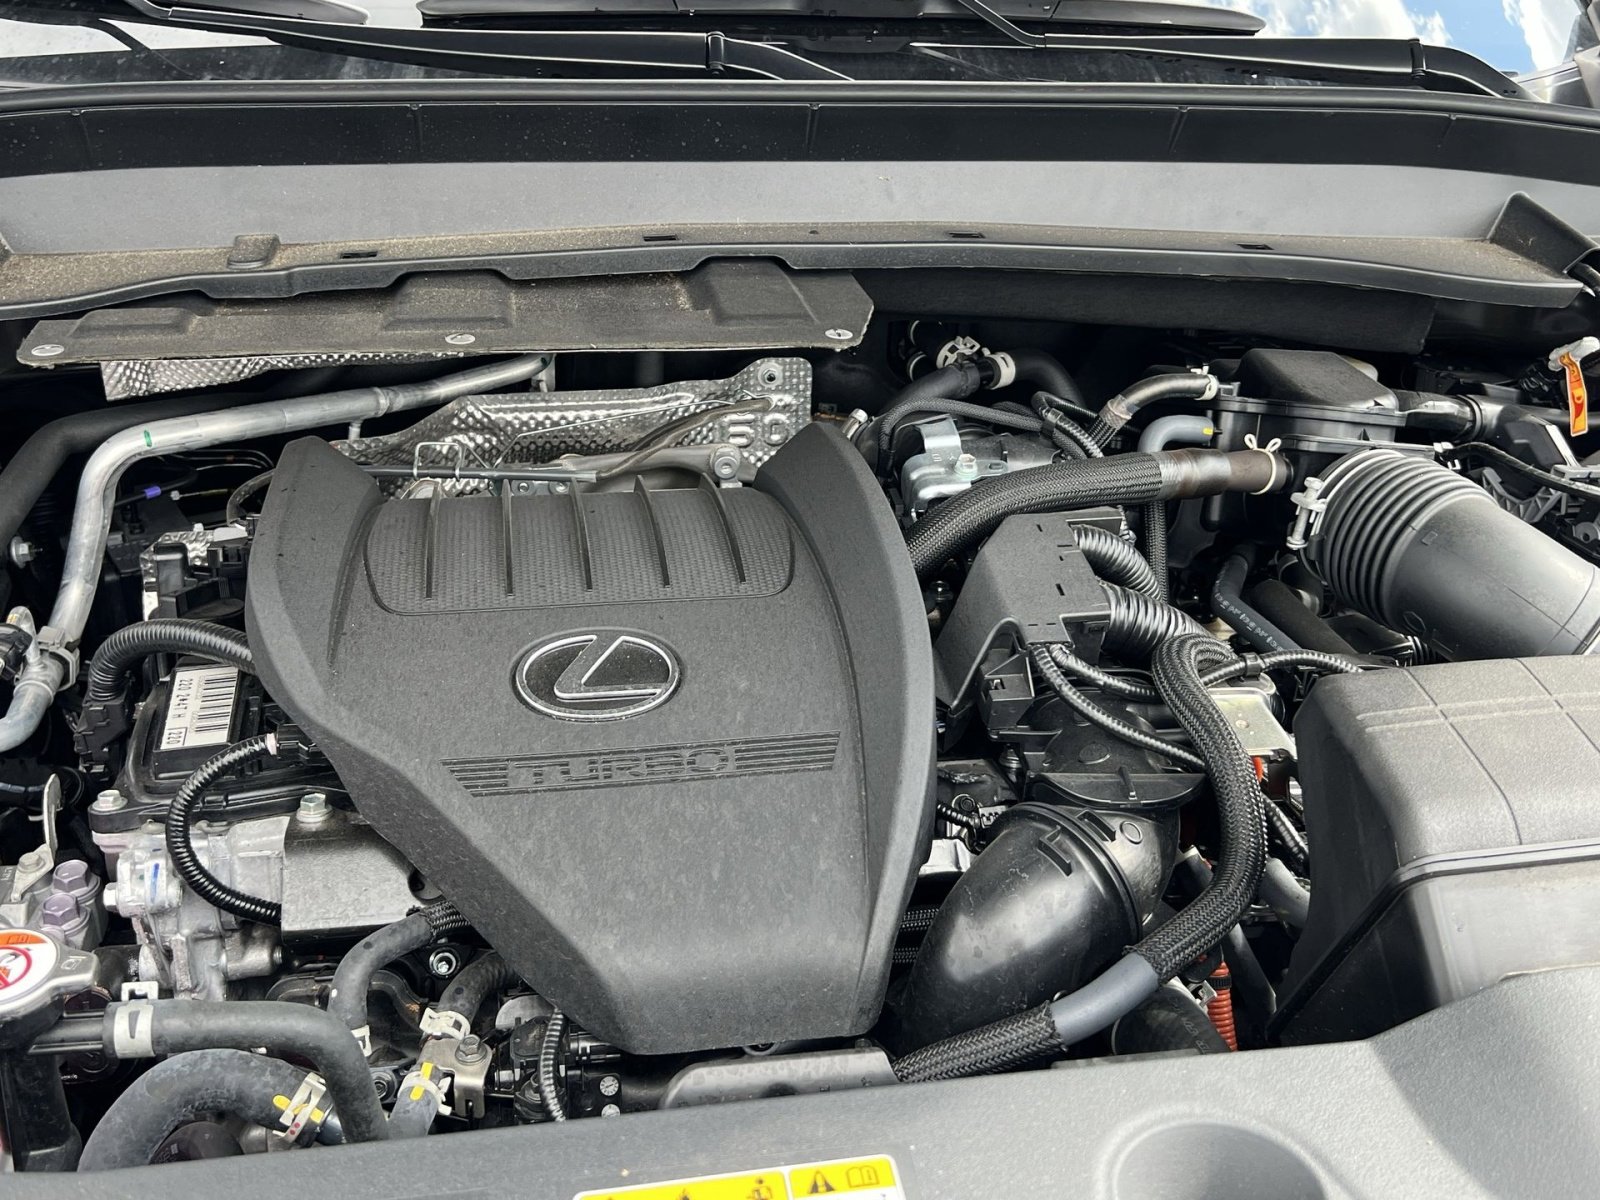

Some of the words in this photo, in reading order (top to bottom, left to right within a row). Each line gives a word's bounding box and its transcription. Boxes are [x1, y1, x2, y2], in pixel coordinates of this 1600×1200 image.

[178, 679, 193, 691] 220
[166, 731, 183, 745] 220
[513, 747, 729, 783] TURBO
